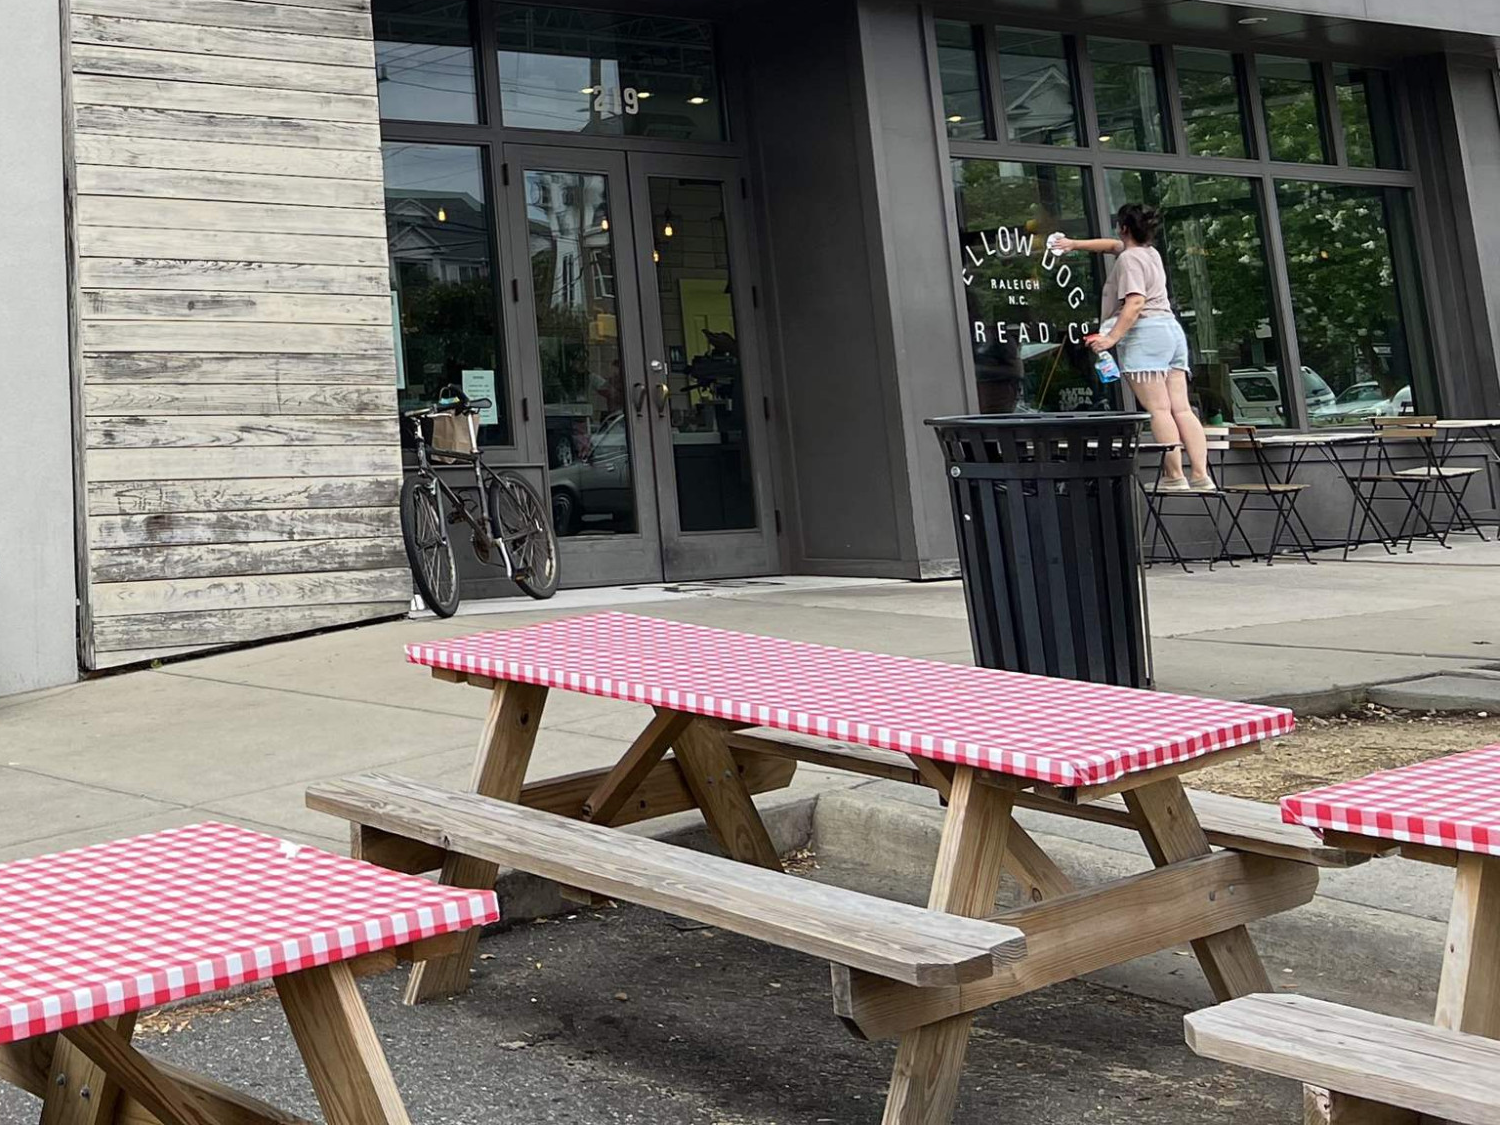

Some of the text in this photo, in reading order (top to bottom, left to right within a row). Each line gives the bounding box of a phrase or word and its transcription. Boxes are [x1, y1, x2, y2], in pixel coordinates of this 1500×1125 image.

[593, 85, 639, 115] 219
[990, 278, 1040, 290] RALEIGH
[1008, 295, 1029, 305] N.C.
